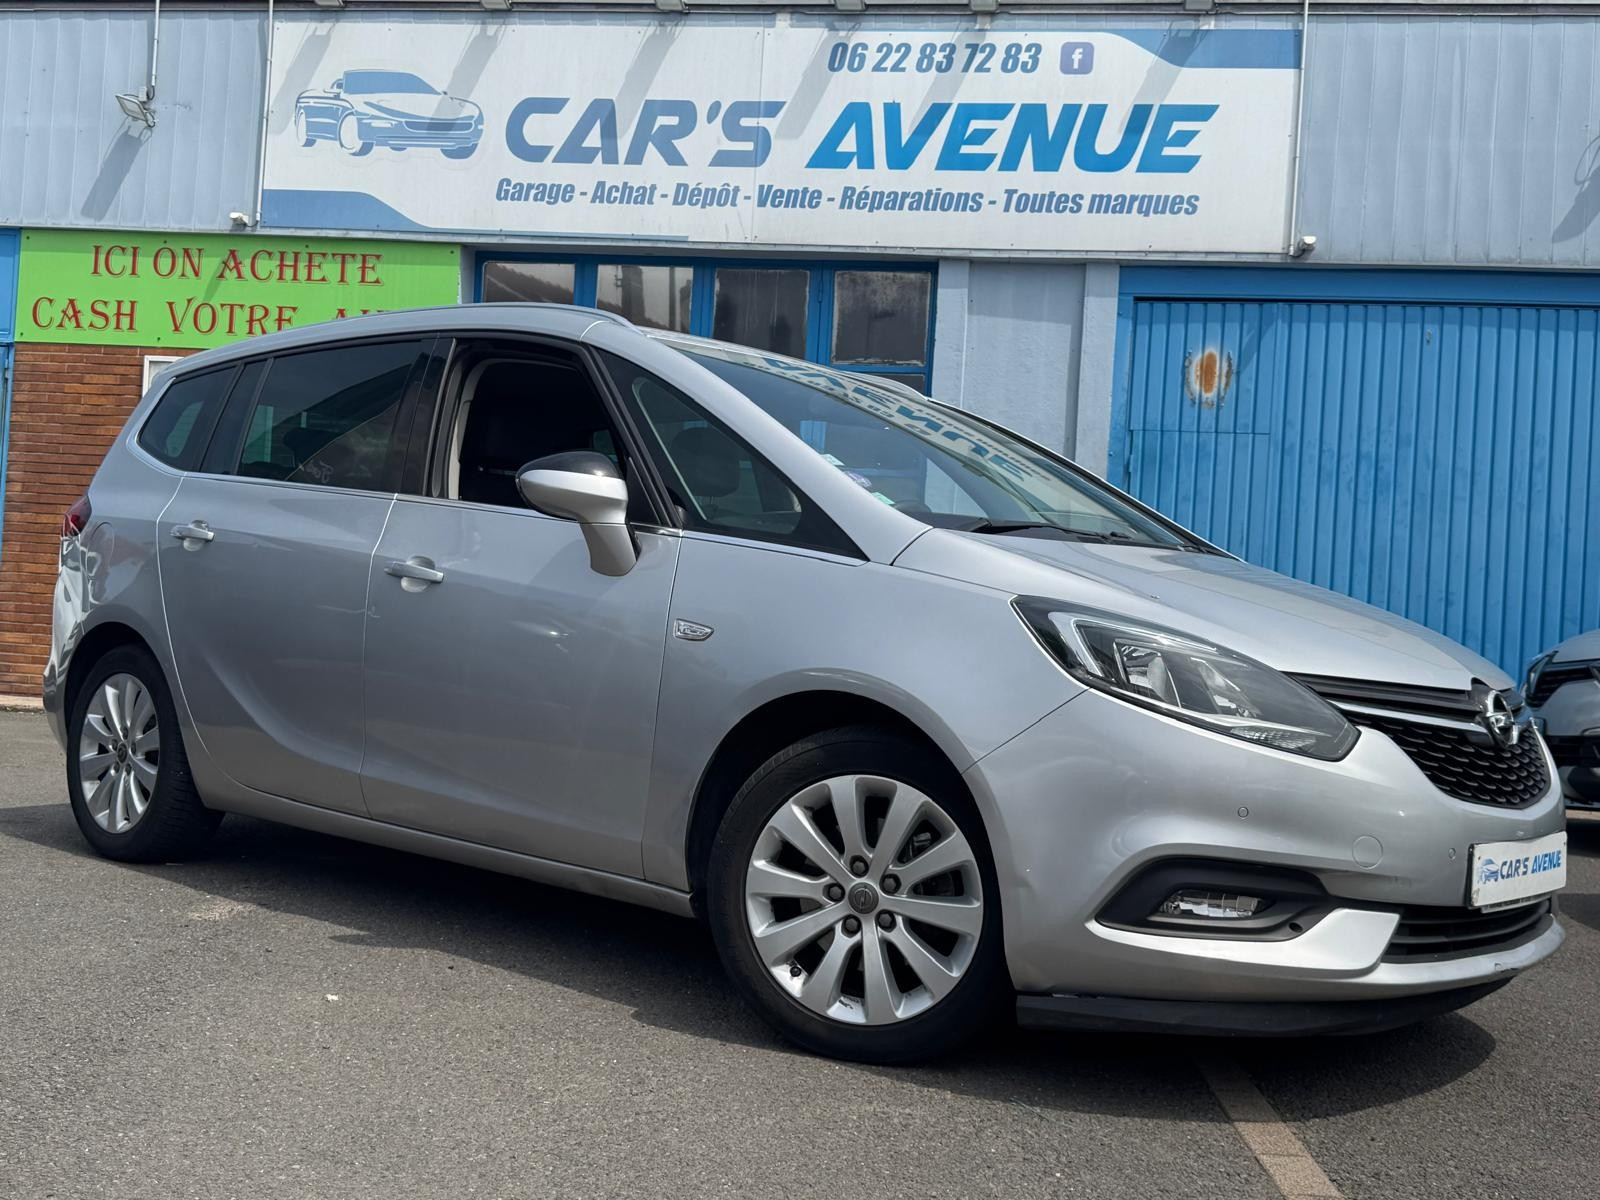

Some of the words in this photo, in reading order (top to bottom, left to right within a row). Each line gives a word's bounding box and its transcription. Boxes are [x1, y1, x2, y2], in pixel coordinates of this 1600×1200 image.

[828, 42, 868, 74] 06
[872, 43, 912, 73] 22
[916, 43, 957, 74] 83
[962, 43, 999, 74] 72
[1000, 43, 1041, 74] 83
[505, 97, 786, 167] CAR'S
[804, 101, 1221, 174] AVENUE
[496, 178, 576, 205] Garage
[591, 180, 656, 206] Achat
[673, 181, 739, 208] Dépôt
[757, 184, 822, 209] Vente
[839, 186, 983, 213] Réparations
[1003, 189, 1083, 214] Toutes
[1087, 192, 1200, 218] marques
[91, 245, 140, 278] ICI
[152, 247, 204, 279] ON
[216, 249, 384, 285] ACHETE
[32, 297, 138, 331] CASH
[1500, 857, 1529, 880] CAR'S
[1530, 850, 1562, 873] AVENUE
